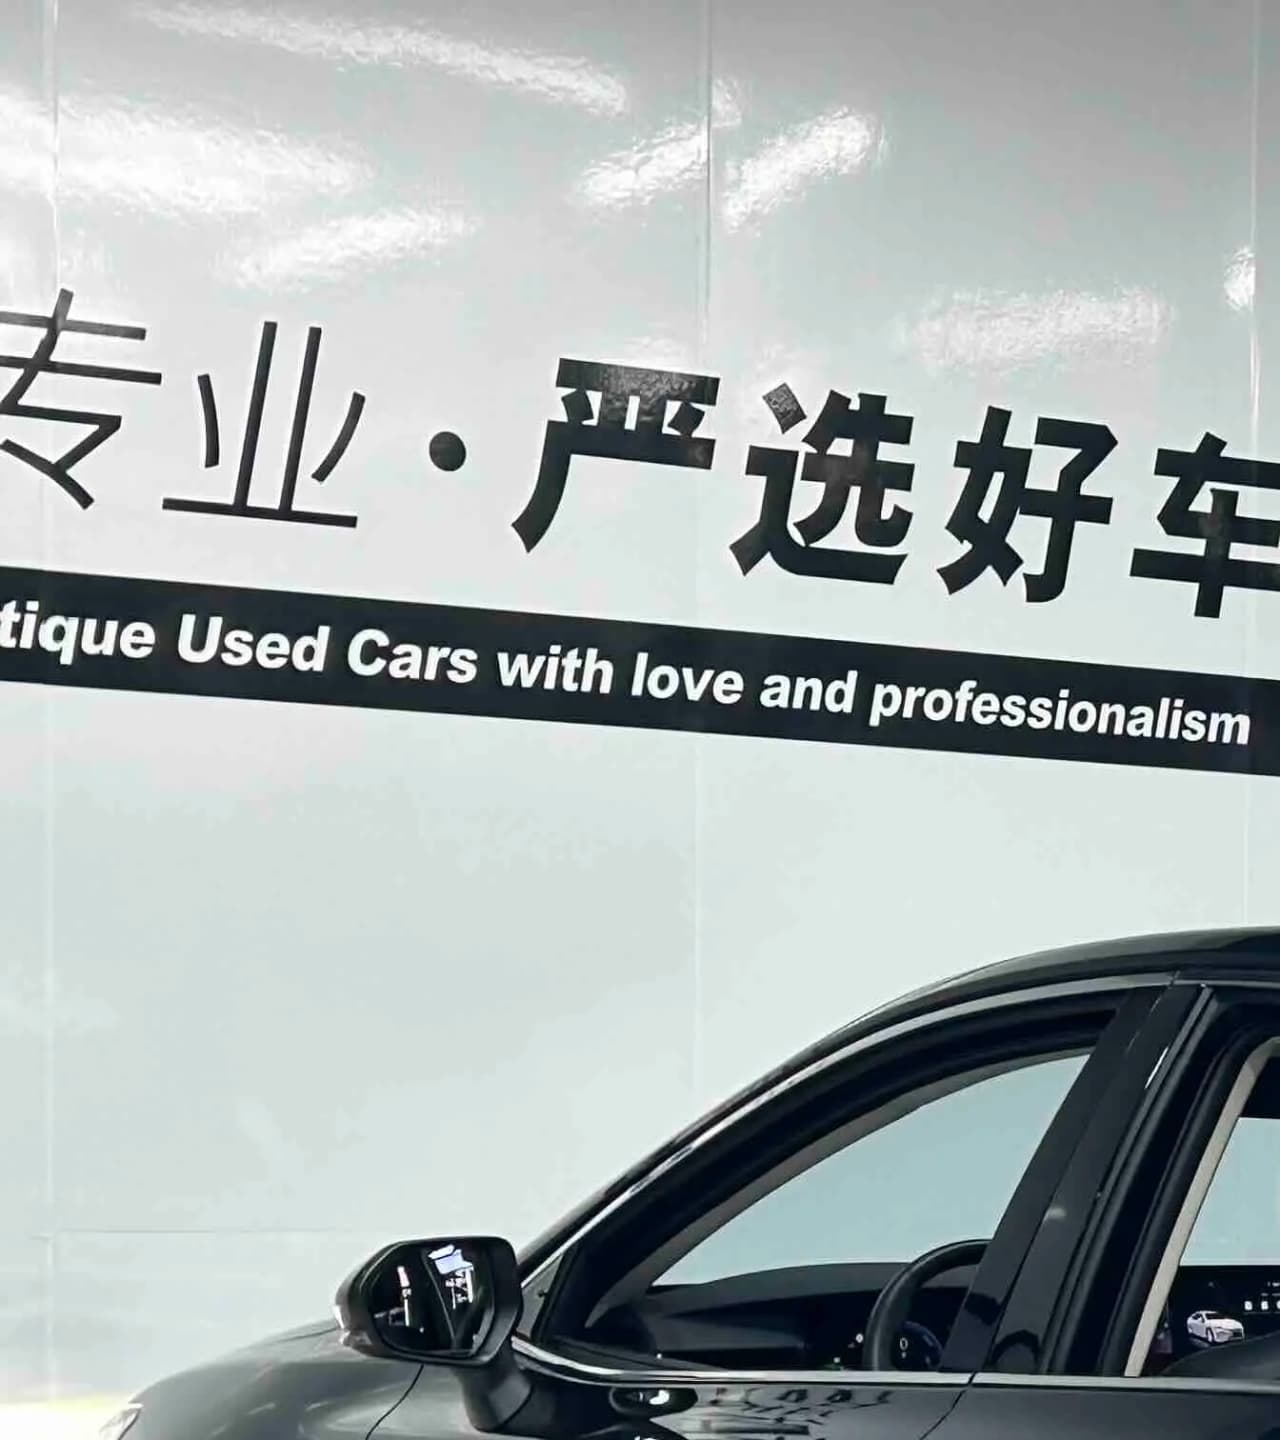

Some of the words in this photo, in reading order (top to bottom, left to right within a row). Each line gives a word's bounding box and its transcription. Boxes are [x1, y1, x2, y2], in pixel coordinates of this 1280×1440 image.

[0, 599, 156, 665] tique
[177, 613, 331, 673] Used
[346, 628, 479, 684] Cars
[497, 646, 615, 695] with
[631, 651, 745, 703] love
[759, 670, 857, 713] and
[869, 679, 1251, 746] professionalism
